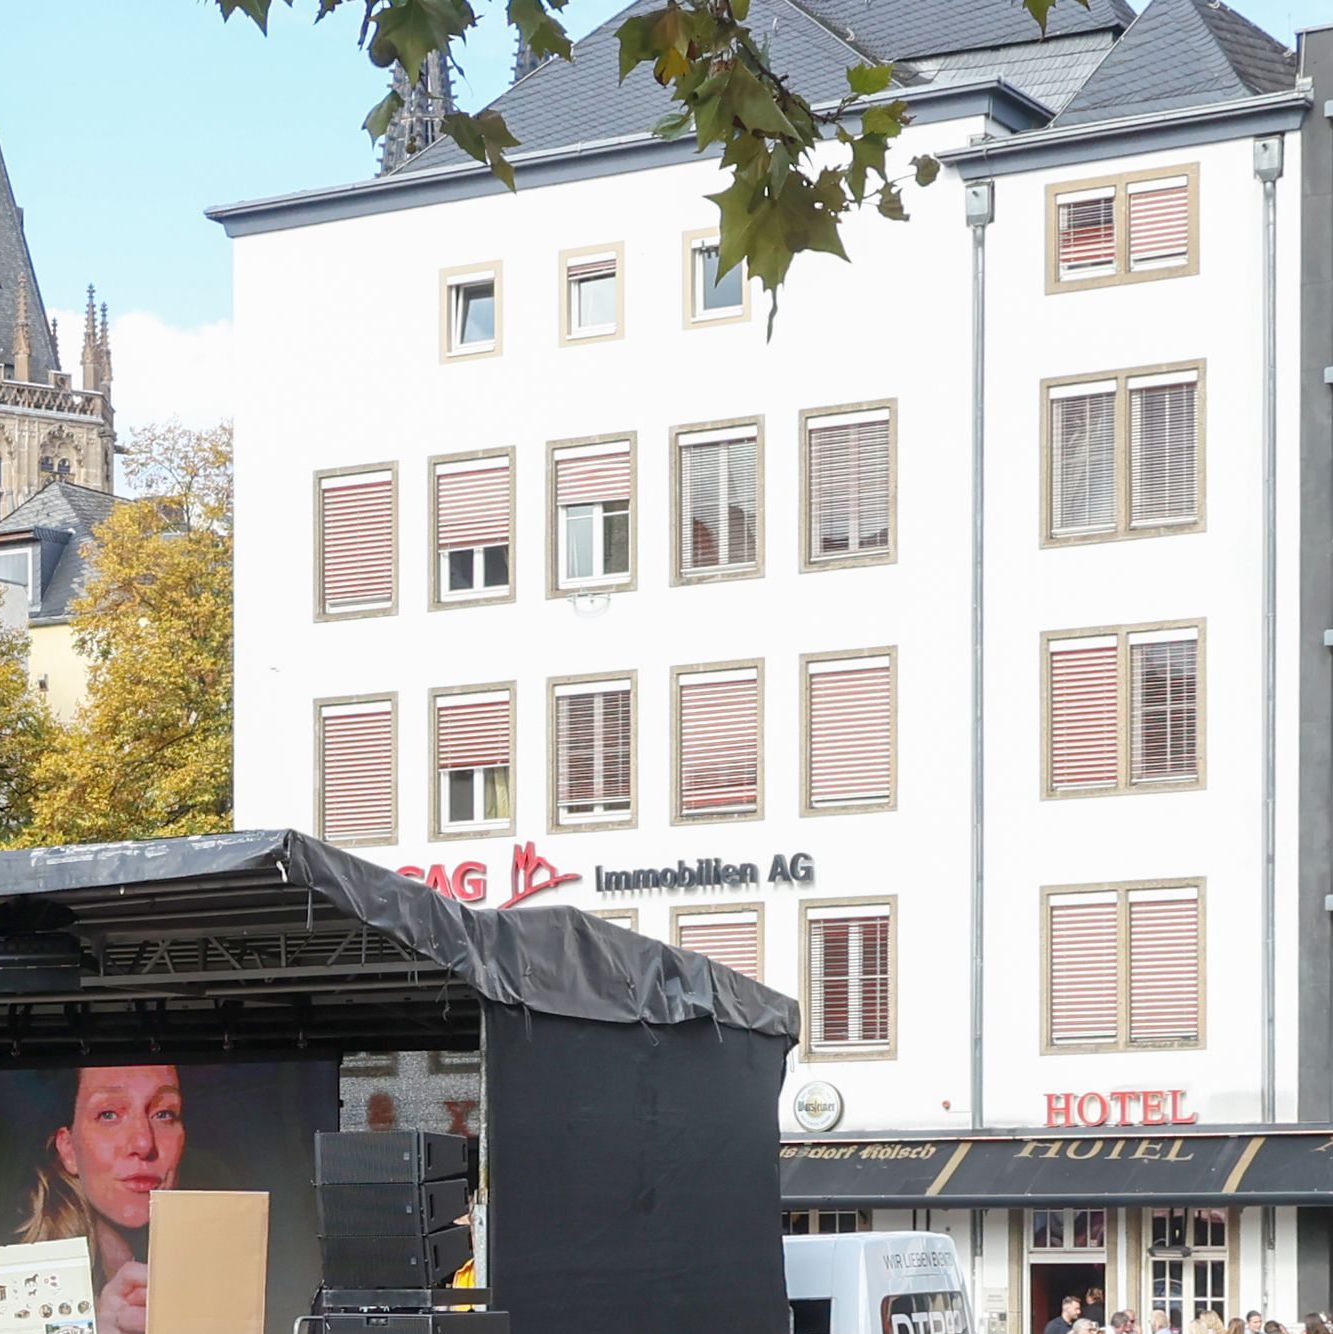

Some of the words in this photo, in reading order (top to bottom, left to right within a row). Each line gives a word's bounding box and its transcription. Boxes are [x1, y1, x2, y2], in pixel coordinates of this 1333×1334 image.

[395, 861, 487, 901] AG
[595, 858, 758, 892] Immobilien
[768, 852, 814, 883] AG
[1044, 1090, 1199, 1127] HOTEL
